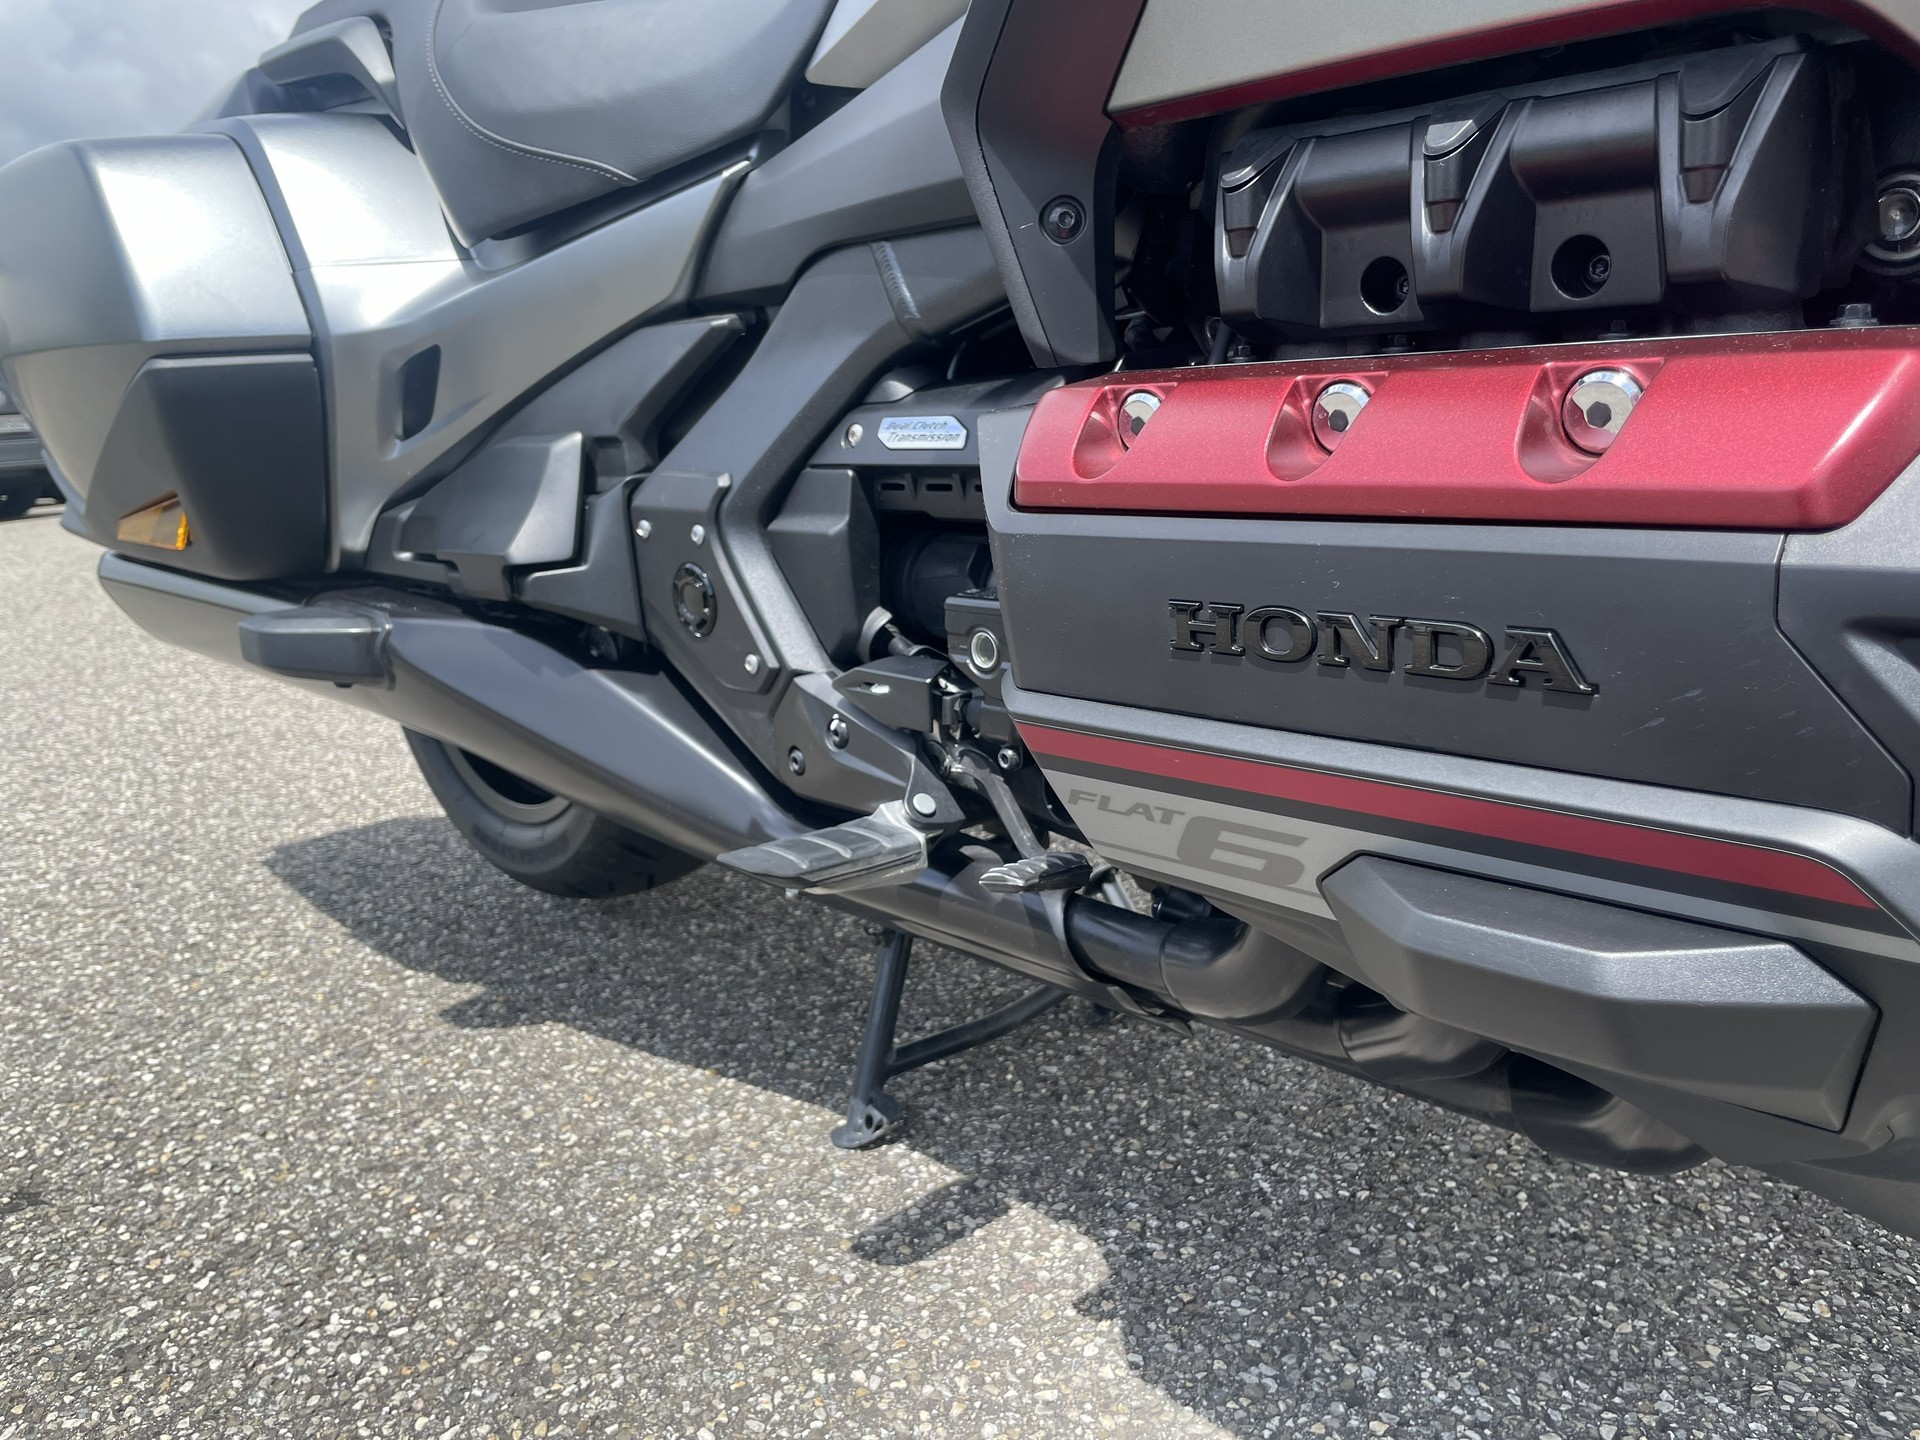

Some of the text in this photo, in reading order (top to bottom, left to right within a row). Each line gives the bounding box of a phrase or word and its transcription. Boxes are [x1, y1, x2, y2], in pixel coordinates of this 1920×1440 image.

[886, 420, 948, 431] Dual Clutch
[887, 432, 961, 442] Transmission
[1168, 598, 1599, 696] HONDA
[1068, 788, 1309, 886] FLAT 6
